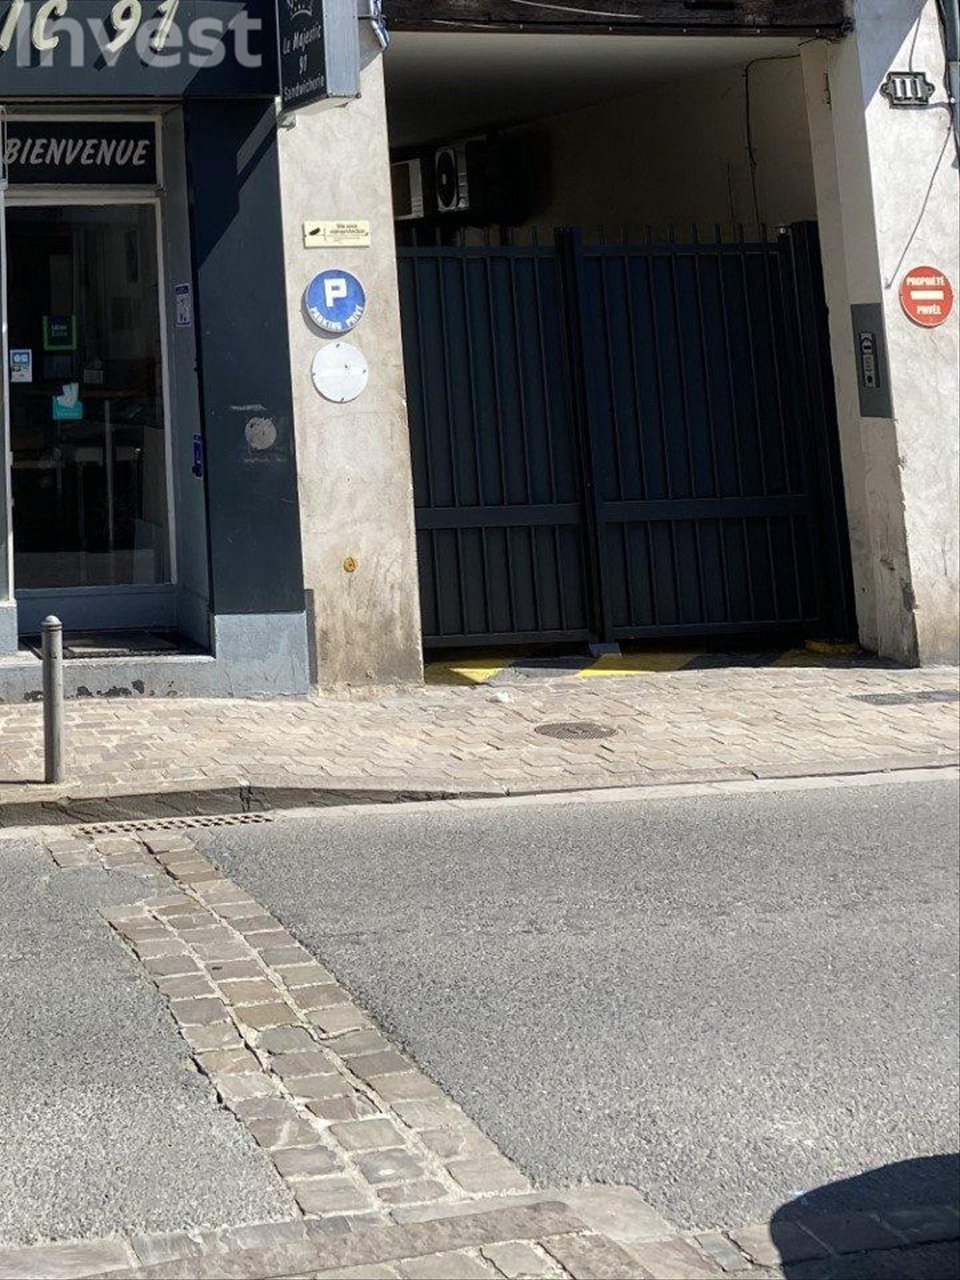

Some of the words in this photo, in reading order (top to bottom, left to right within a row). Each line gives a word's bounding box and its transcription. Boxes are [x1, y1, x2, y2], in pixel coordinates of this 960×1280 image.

[299, 53, 307, 75] 91
[3, 138, 150, 166] BIENVENUE
[324, 279, 347, 307] P
